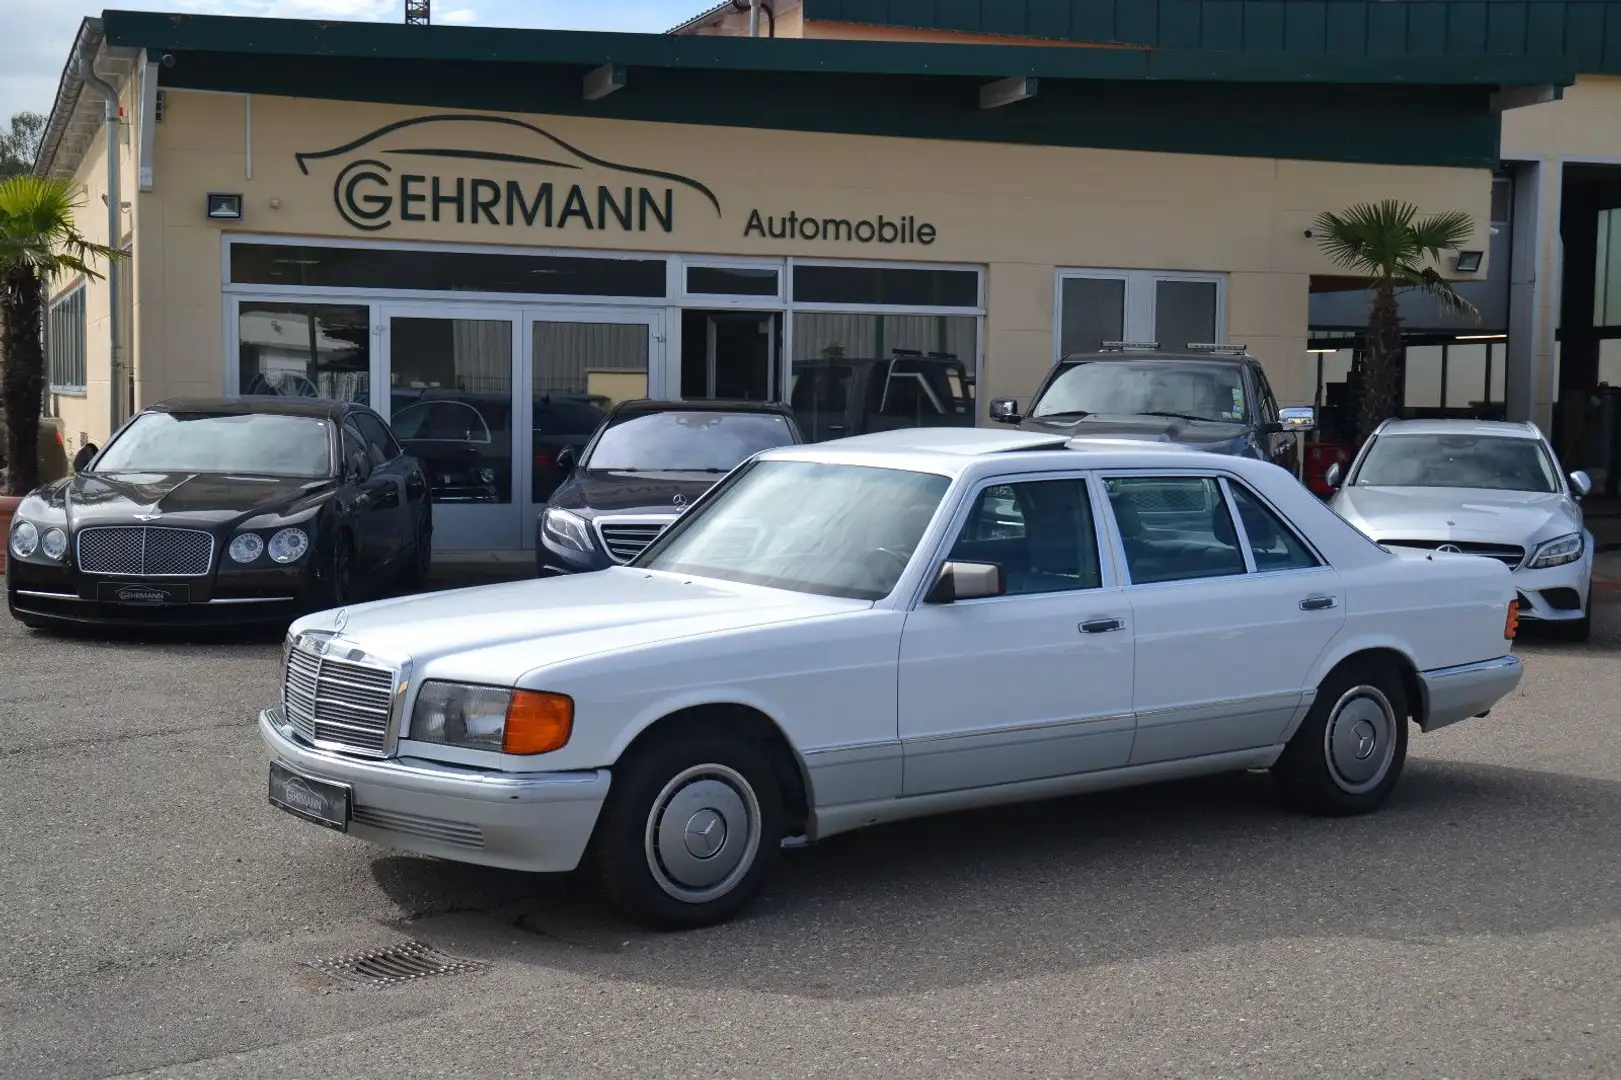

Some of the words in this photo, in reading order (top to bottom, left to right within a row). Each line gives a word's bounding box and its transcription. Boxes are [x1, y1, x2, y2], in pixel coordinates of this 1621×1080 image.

[334, 159, 673, 232] GEHRMANN
[744, 209, 936, 245] Automobile
[119, 590, 164, 600] GEHRMANN
